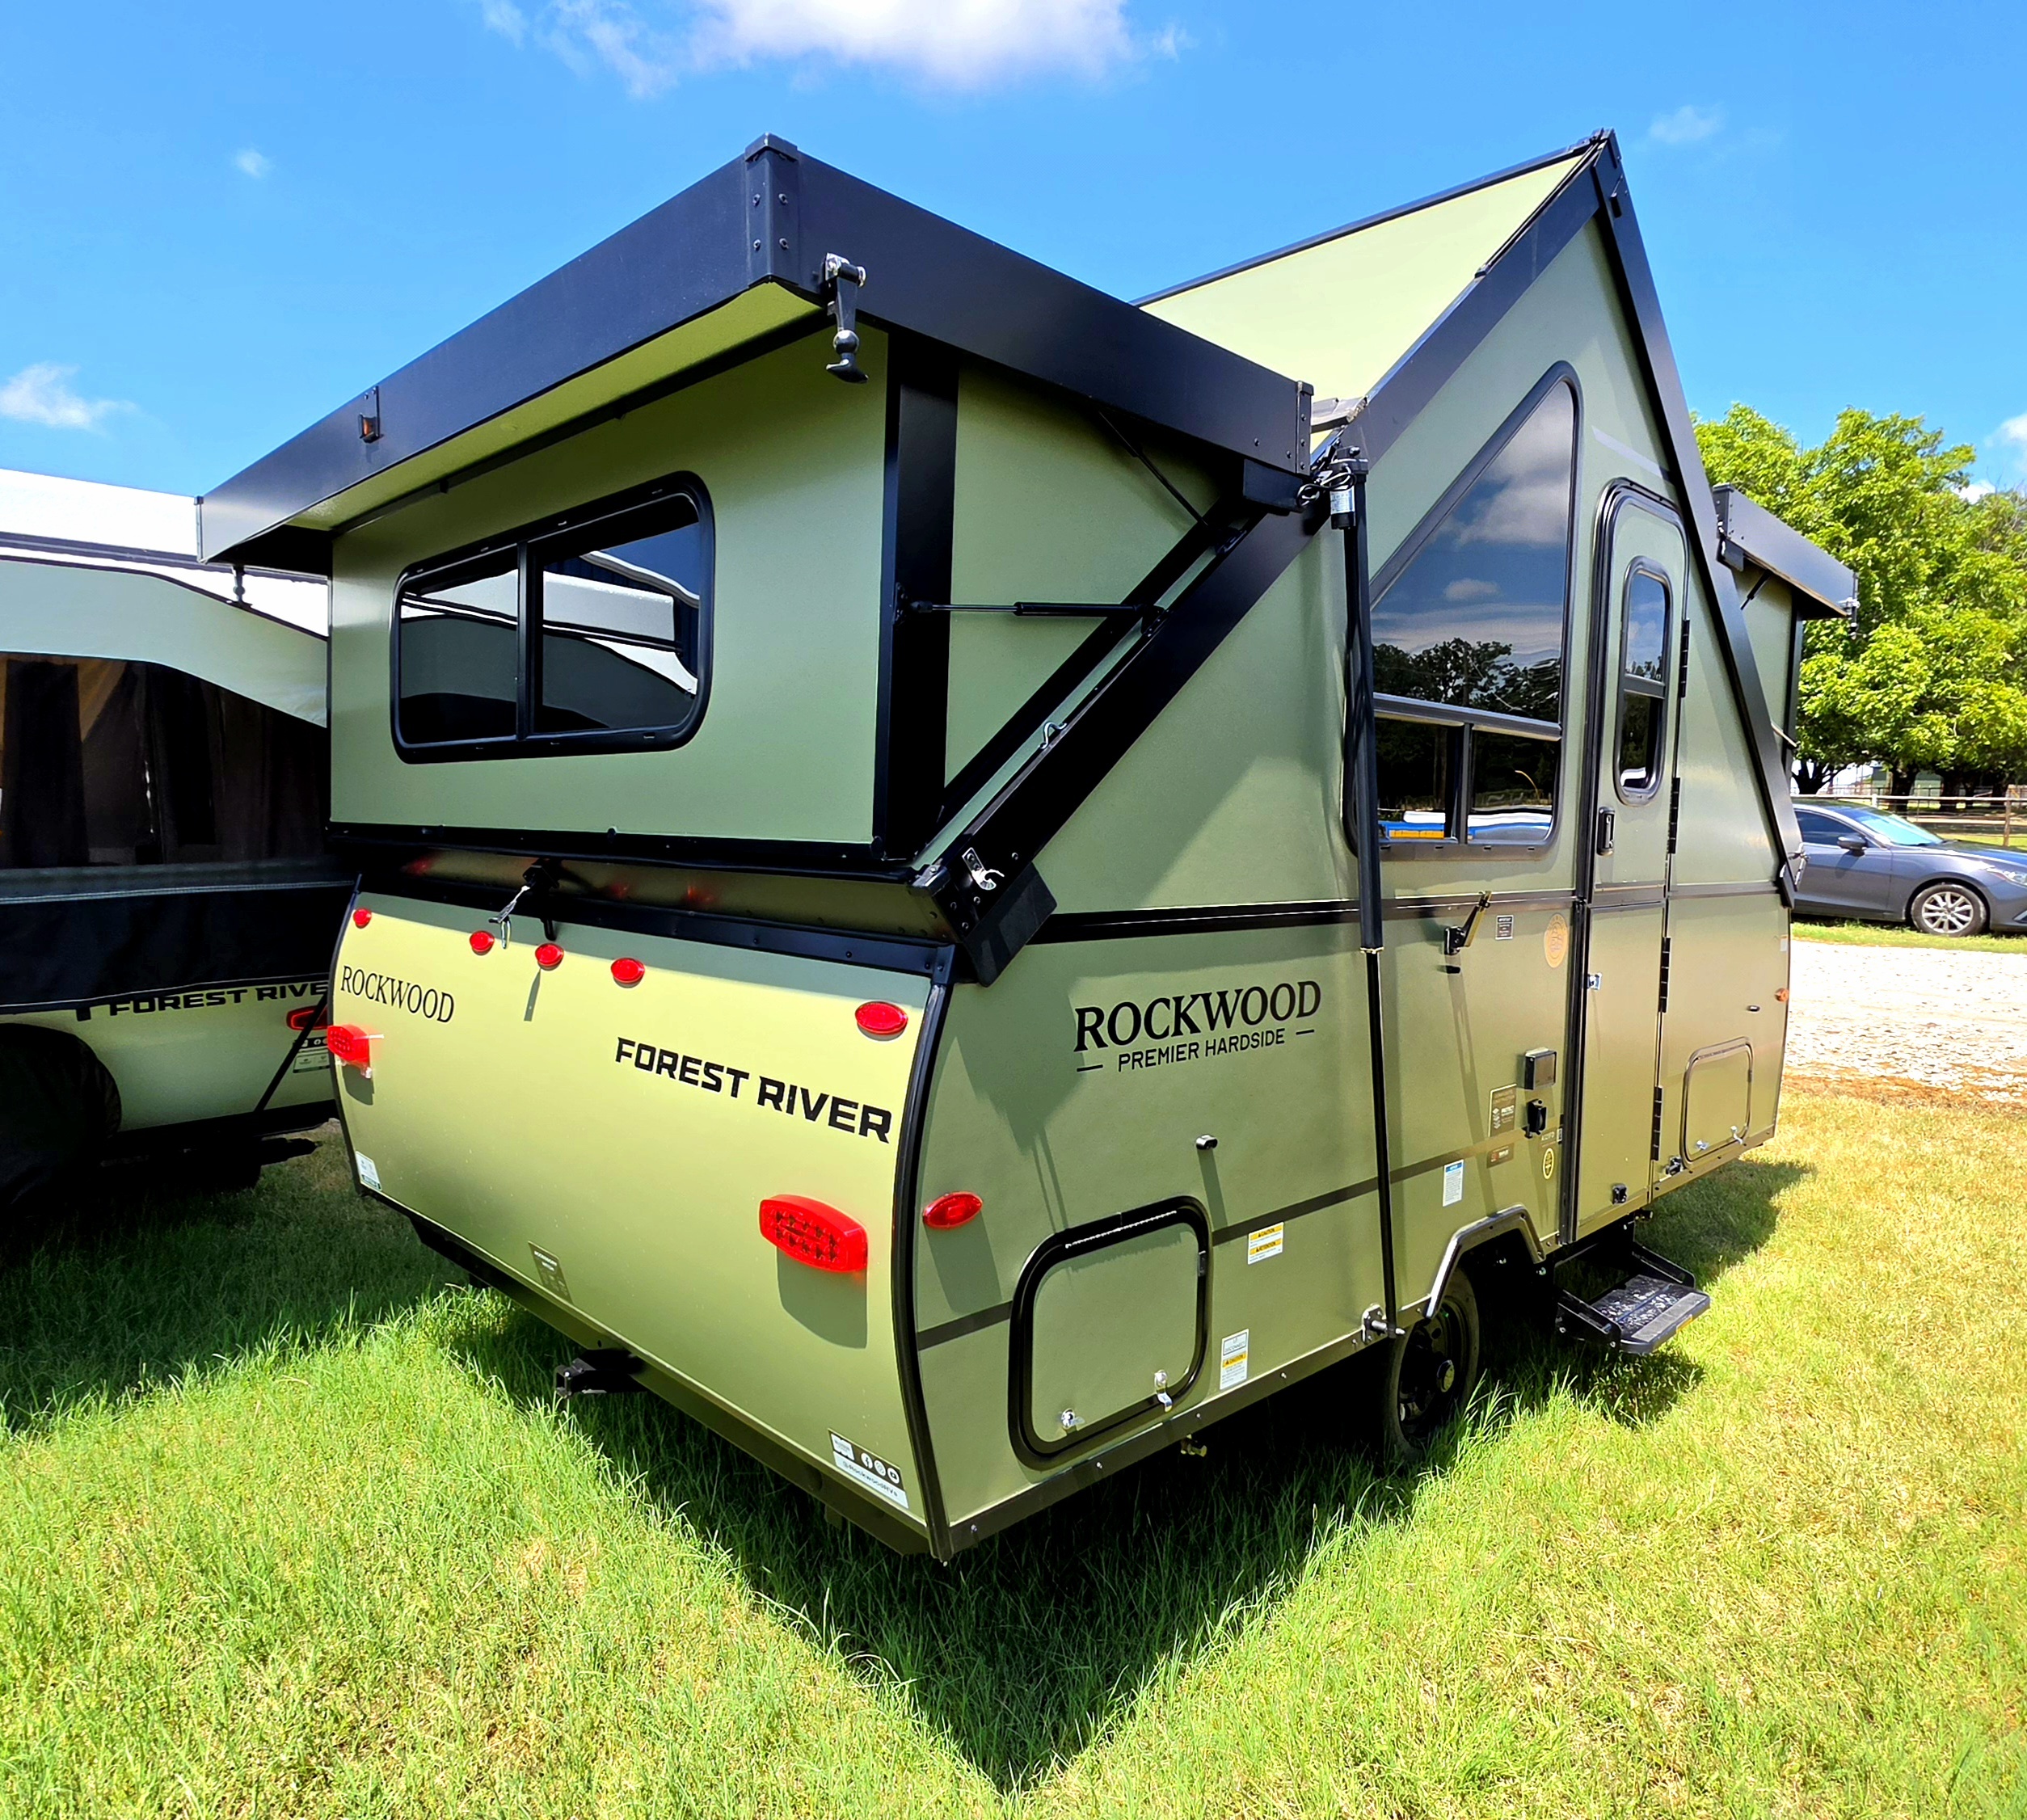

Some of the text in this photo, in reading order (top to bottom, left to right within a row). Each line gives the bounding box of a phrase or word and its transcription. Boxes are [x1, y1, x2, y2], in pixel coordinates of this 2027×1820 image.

[110, 981, 328, 1016] FOREST RIVE
[340, 965, 454, 1023] ROCKWOOD
[1073, 980, 1321, 1052] ROCKWOOD
[1118, 1028, 1286, 1072] PREMIER HARDSIDE
[615, 1036, 892, 1144] FOREST RIVER
